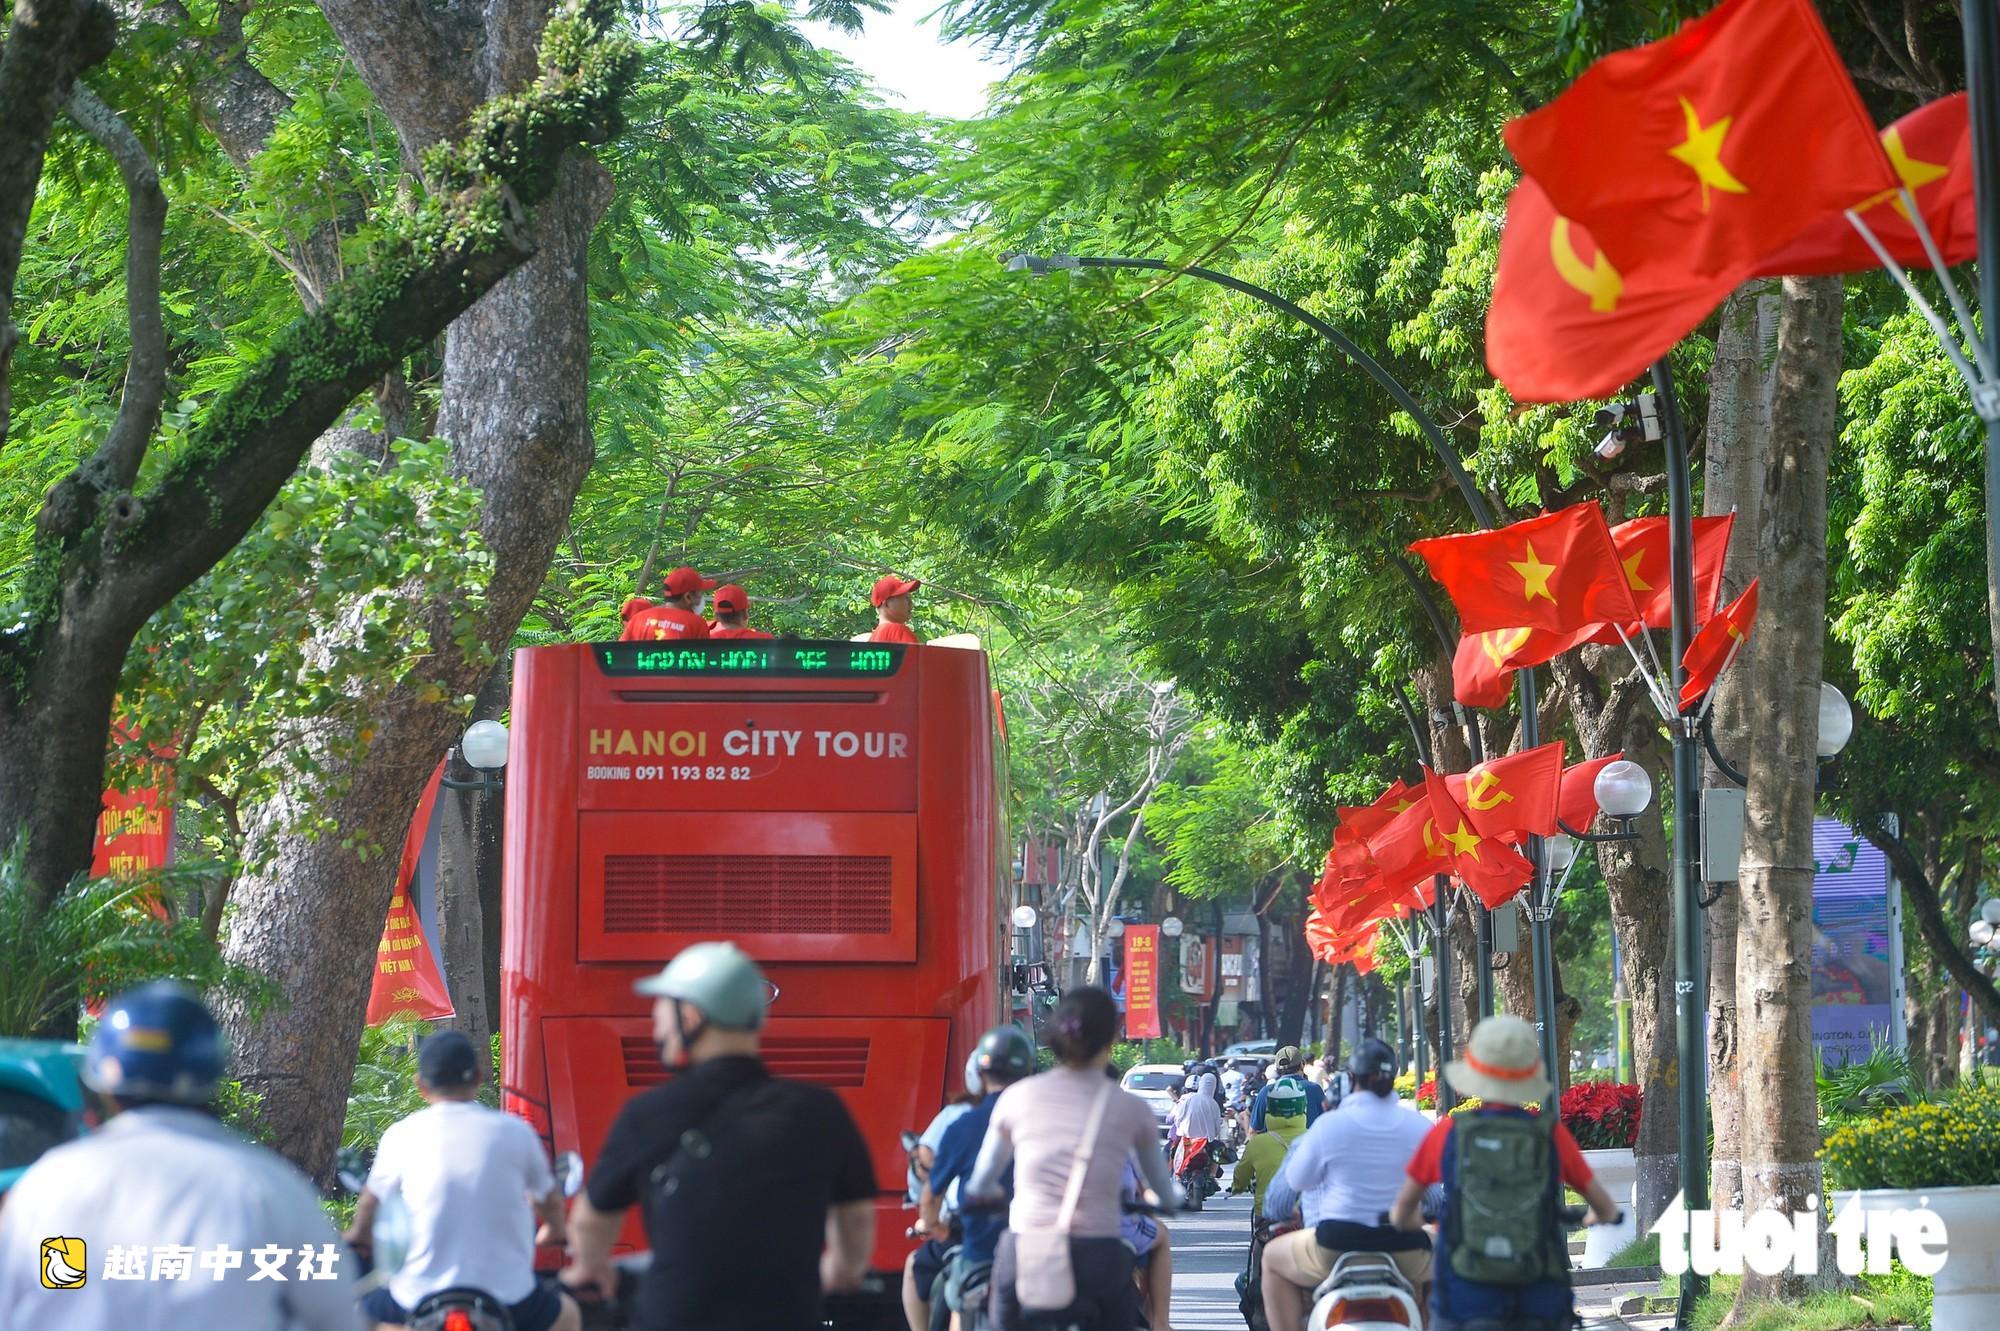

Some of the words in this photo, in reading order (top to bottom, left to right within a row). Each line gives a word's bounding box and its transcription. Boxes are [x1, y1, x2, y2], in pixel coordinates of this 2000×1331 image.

[589, 728, 707, 757] HANOI
[722, 729, 803, 758] CITY
[814, 731, 908, 758] TOUR
[587, 766, 631, 780] BOOKING
[635, 766, 665, 780] 091
[671, 766, 701, 780] 193
[705, 766, 726, 780] 82
[730, 766, 751, 780] 82
